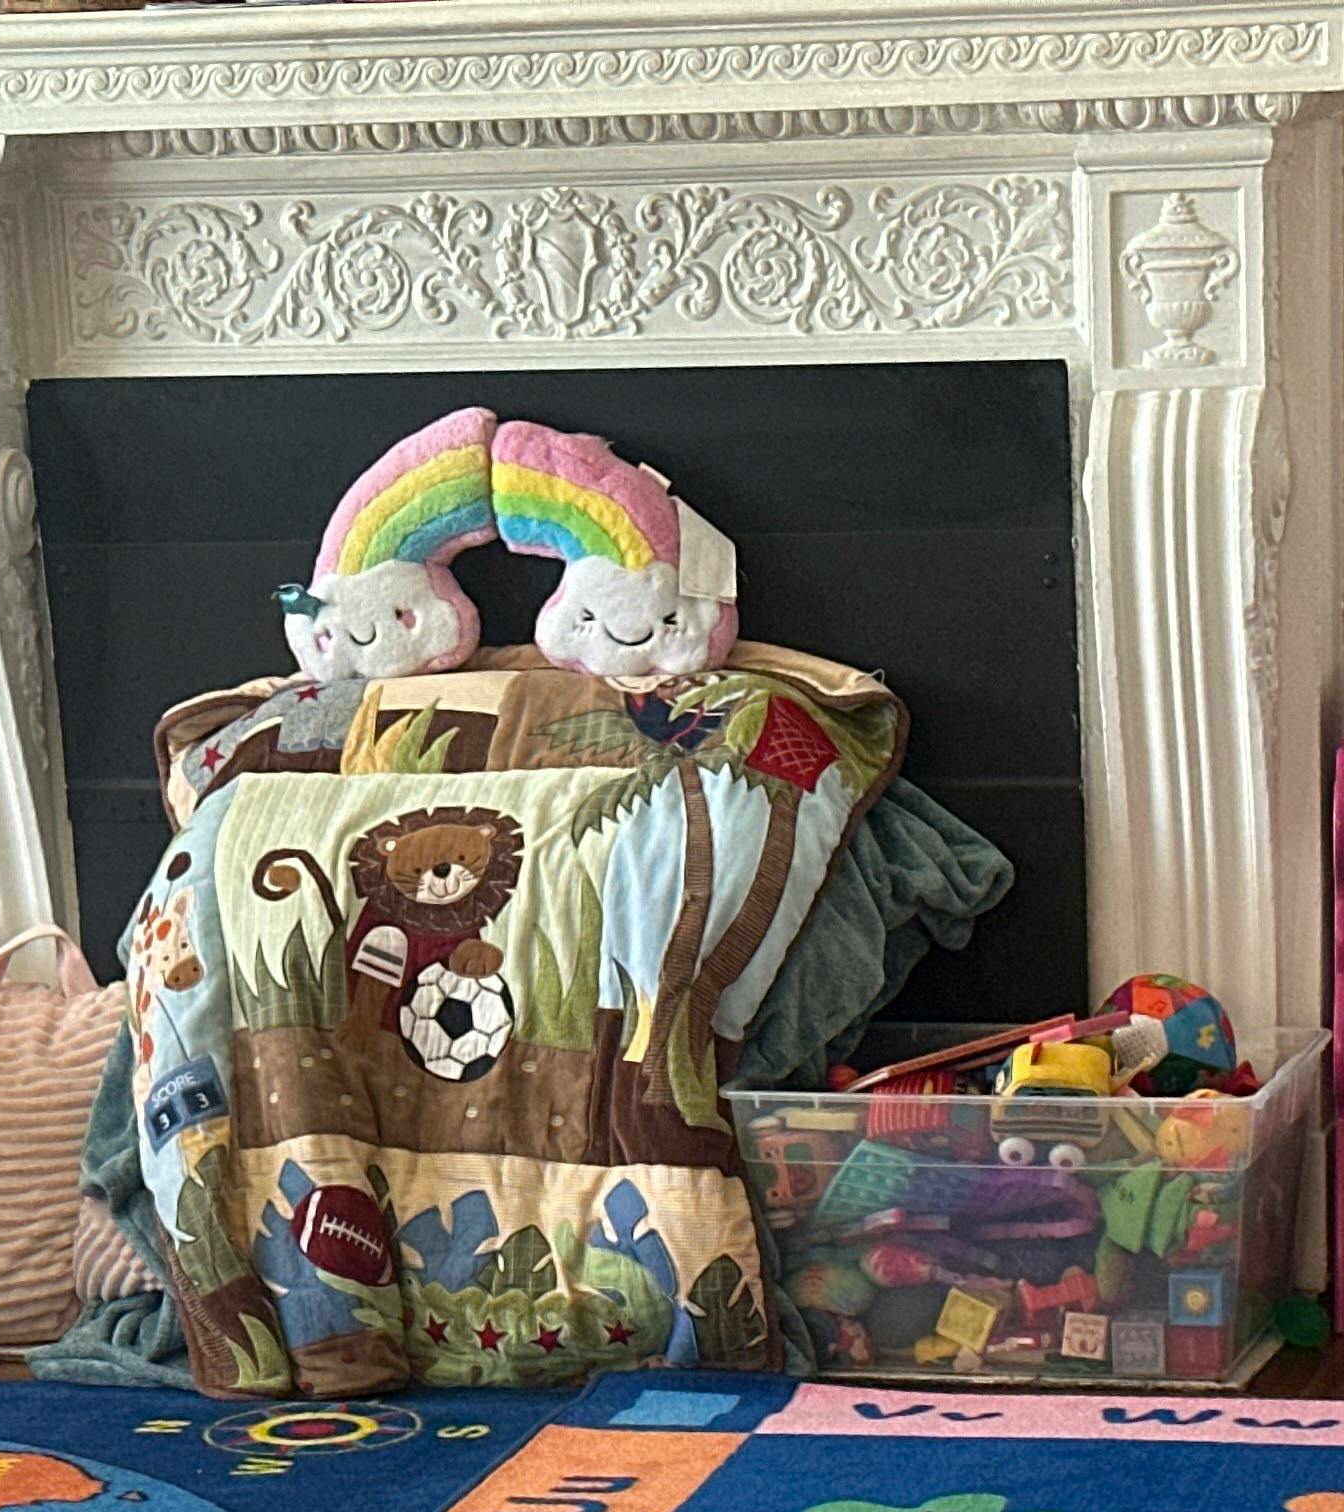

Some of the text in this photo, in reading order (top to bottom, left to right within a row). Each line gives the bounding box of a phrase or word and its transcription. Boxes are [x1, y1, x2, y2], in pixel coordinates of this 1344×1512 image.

[152, 1072, 196, 1108] SCORE
[196, 1093, 210, 1109] 3
[158, 1112, 170, 1131] 3
[852, 1402, 1005, 1421] Vv
[1100, 1407, 1343, 1430] Ww
[133, 1419, 192, 1434] N
[436, 1424, 491, 1440] S
